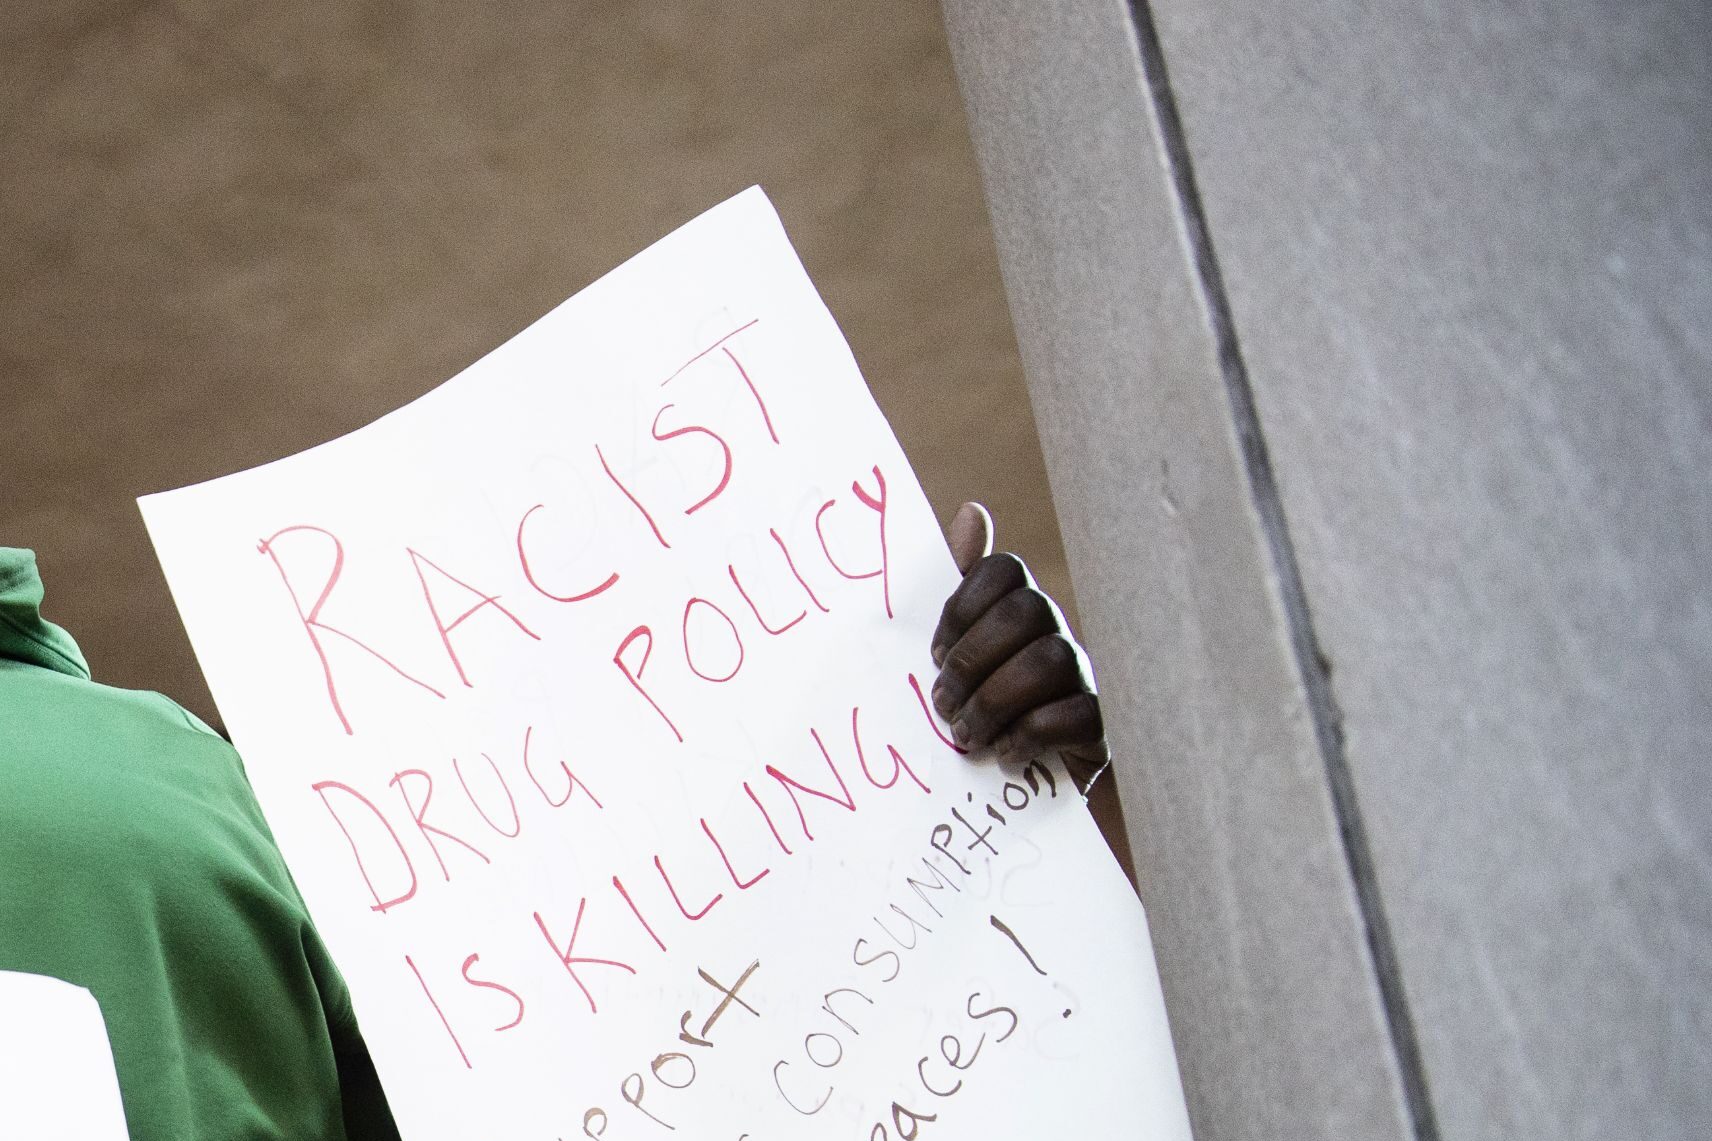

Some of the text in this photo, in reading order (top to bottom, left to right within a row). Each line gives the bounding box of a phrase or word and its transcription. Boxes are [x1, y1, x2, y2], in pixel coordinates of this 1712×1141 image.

[258, 318, 779, 735] RACIST
[312, 464, 894, 913] DRUG POLICY
[404, 706, 933, 1069] IS KILLING
